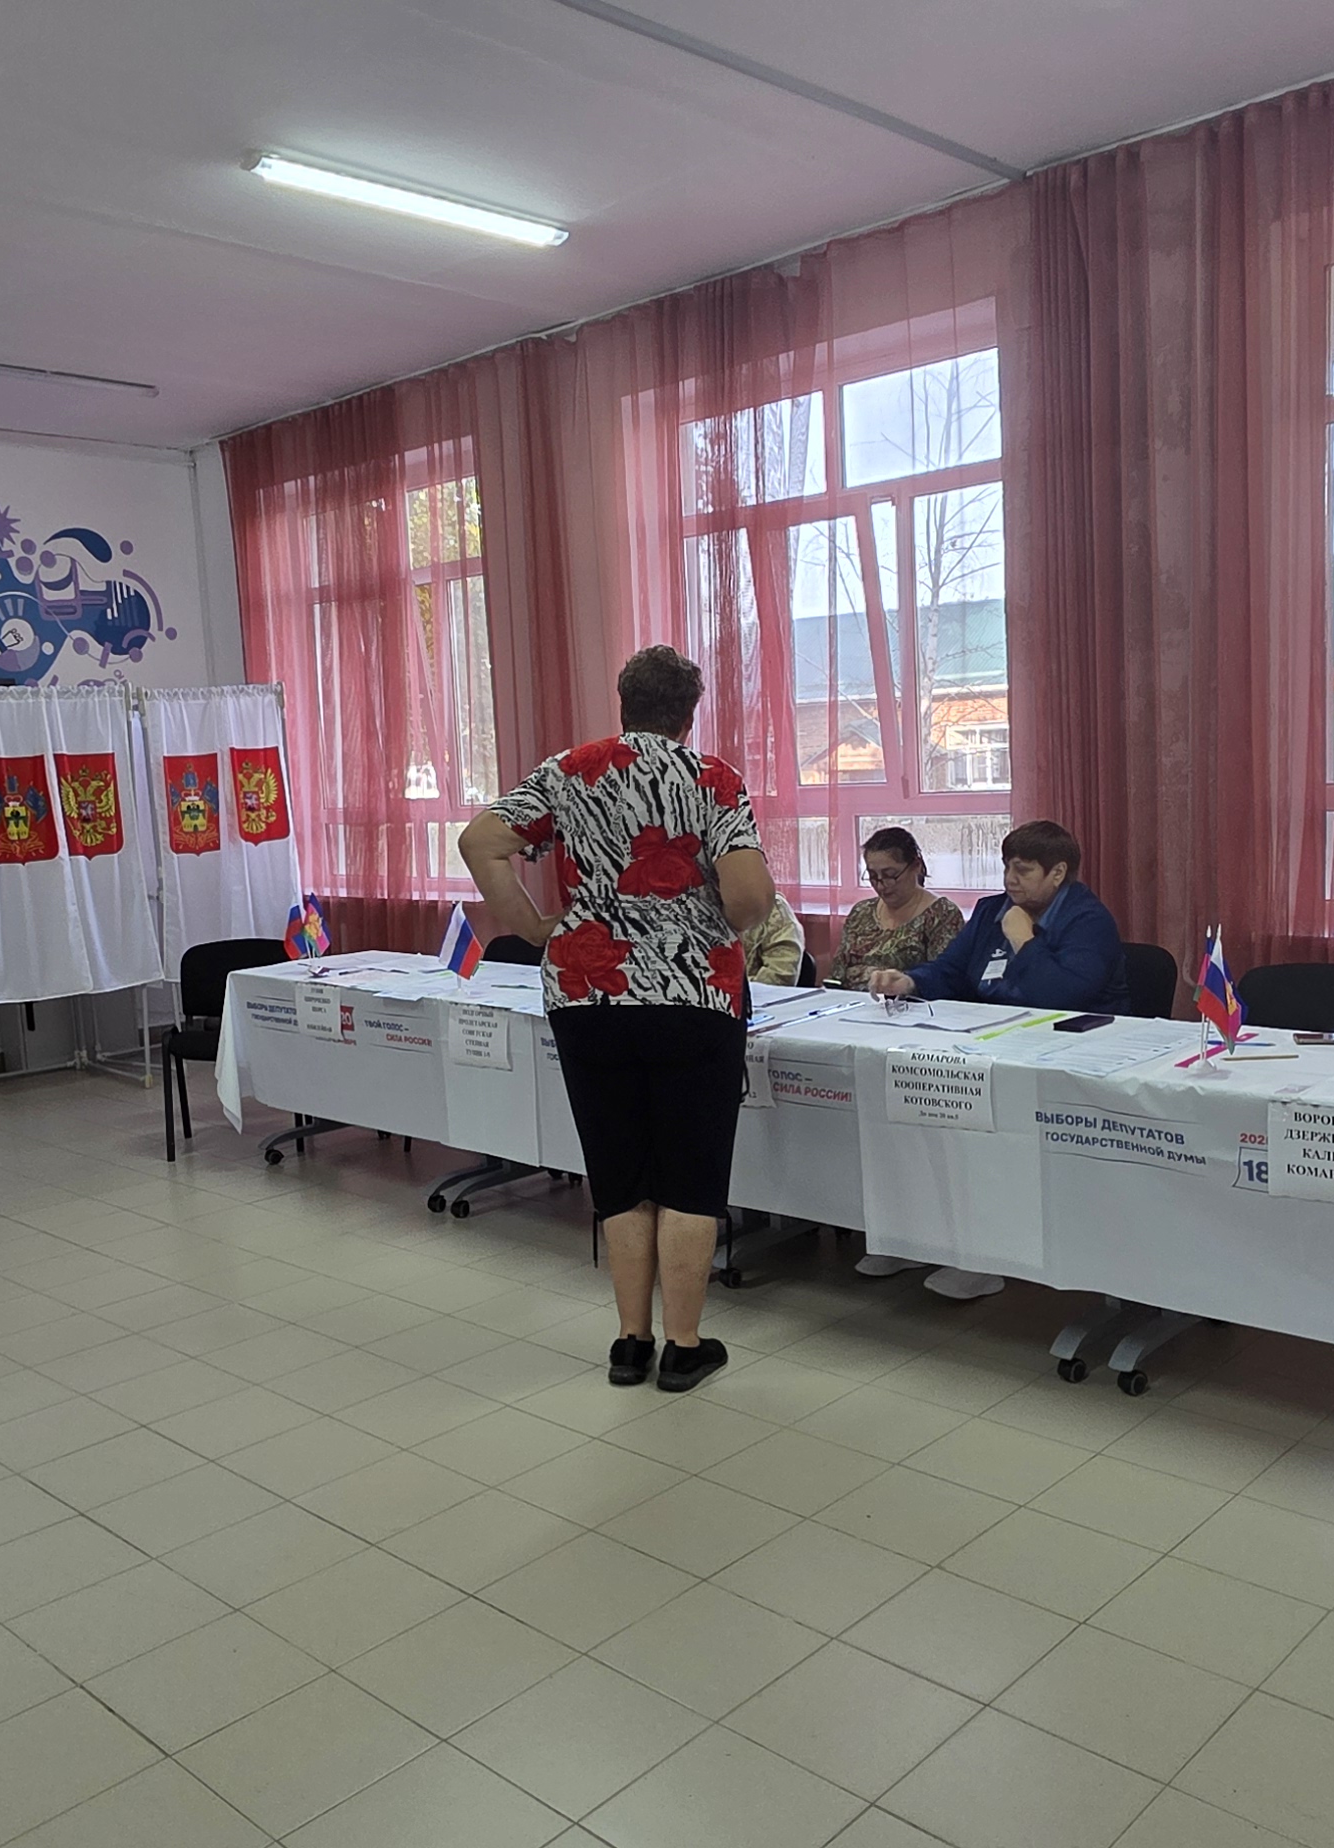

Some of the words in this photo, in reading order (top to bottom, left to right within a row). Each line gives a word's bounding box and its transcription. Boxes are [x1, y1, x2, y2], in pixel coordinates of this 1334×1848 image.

[268, 1003, 297, 1016] ДЕПУТАТО
[364, 1019, 382, 1030] ТВОЙ
[382, 1021, 403, 1032] ГОЛОС
[386, 1033, 404, 1044] СИЛА
[910, 1052, 966, 1065] КОМАРОВА
[891, 1065, 985, 1082] КОМСОМОЛЬСКАЯ
[773, 1081, 802, 1095] СИЛА
[804, 1086, 852, 1102] РОССИИ!
[894, 1080, 982, 1097] КООПЕРАТИВНАЯ
[903, 1095, 973, 1111] КОТОВСКОГО
[1035, 1111, 1098, 1129] ВЫБОРЫ
[1101, 1118, 1185, 1145] ДЕПУТАТОВ
[1240, 1132, 1268, 1145] 202
[1045, 1131, 1164, 1158] ГОСУДАРСТВЕННОЙ
[1167, 1150, 1207, 1165] ДУМЫ
